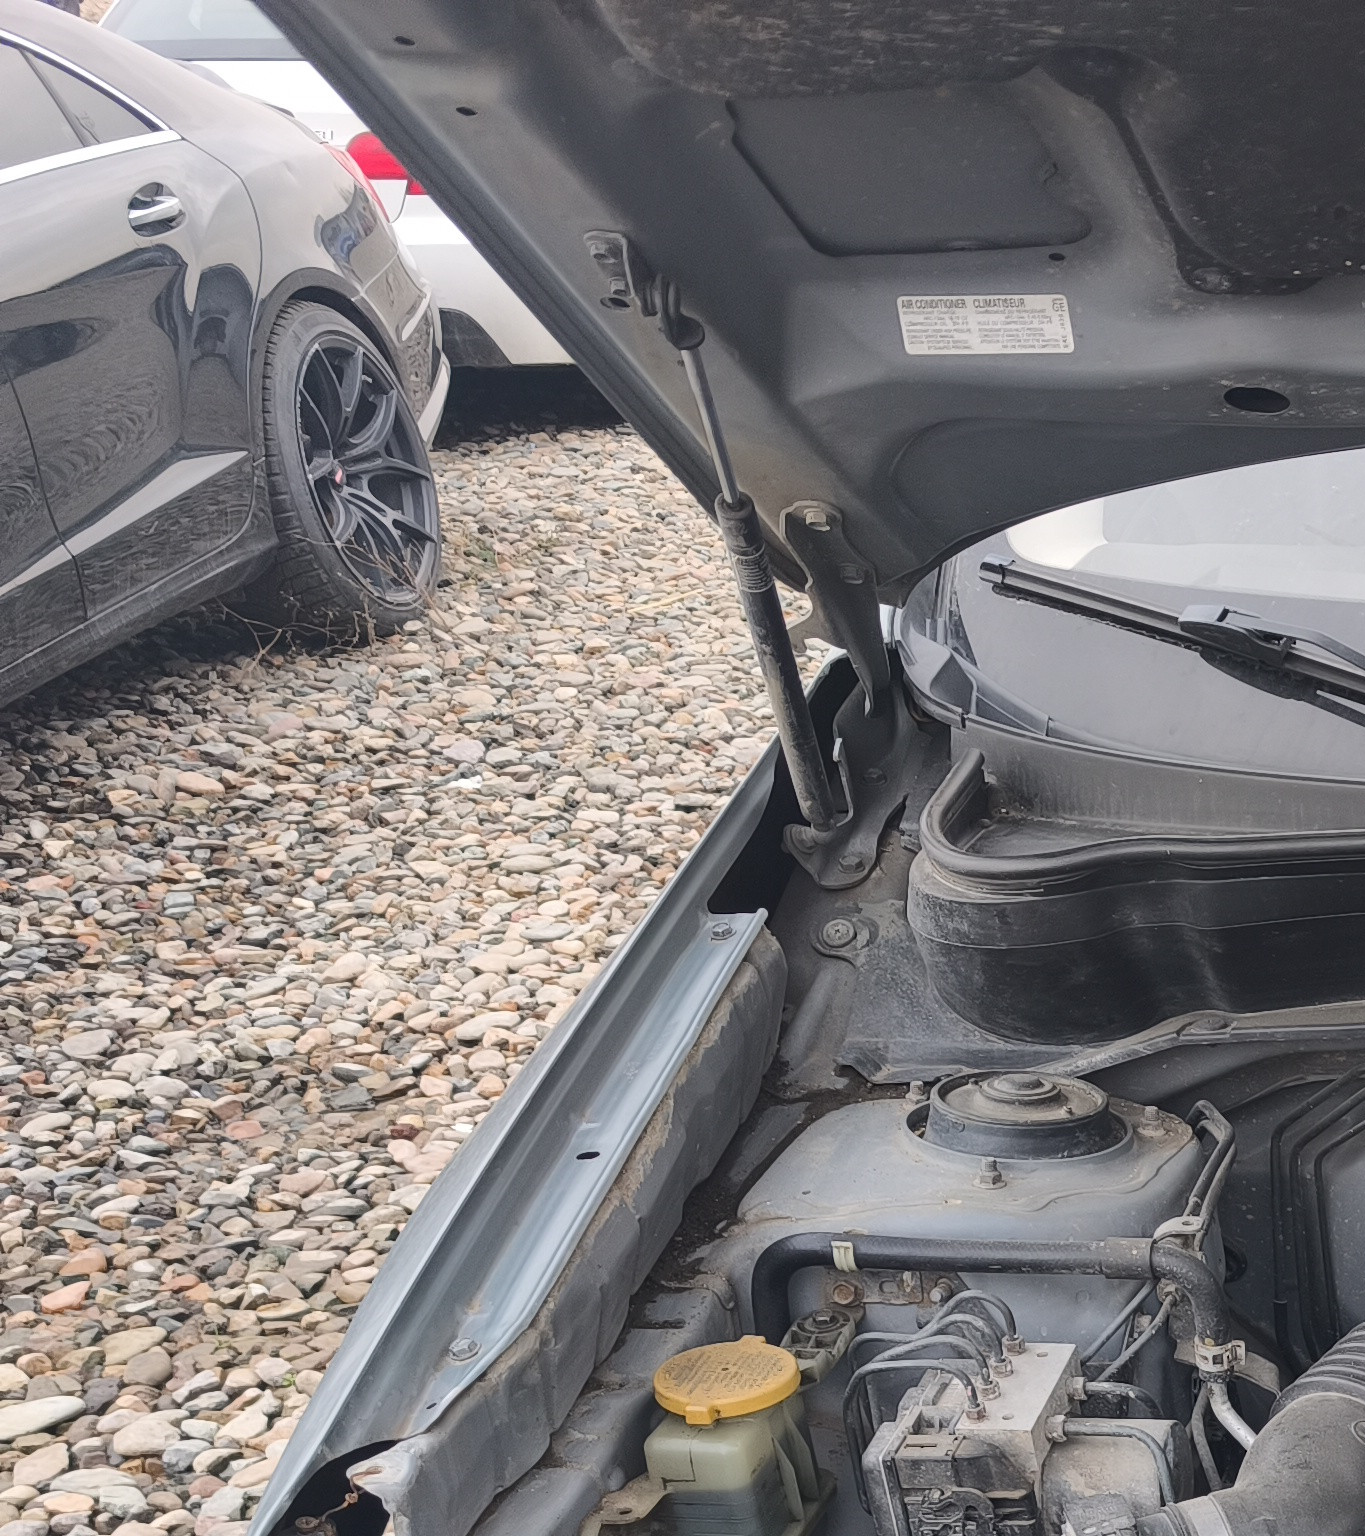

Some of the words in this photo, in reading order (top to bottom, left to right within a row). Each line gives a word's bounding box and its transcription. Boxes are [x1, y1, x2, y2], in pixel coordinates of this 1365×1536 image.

[901, 299, 914, 309] AIR
[915, 298, 967, 309] CONDITIONER
[973, 297, 1026, 308] CLIMATISEUR
[1052, 302, 1066, 312] GE
